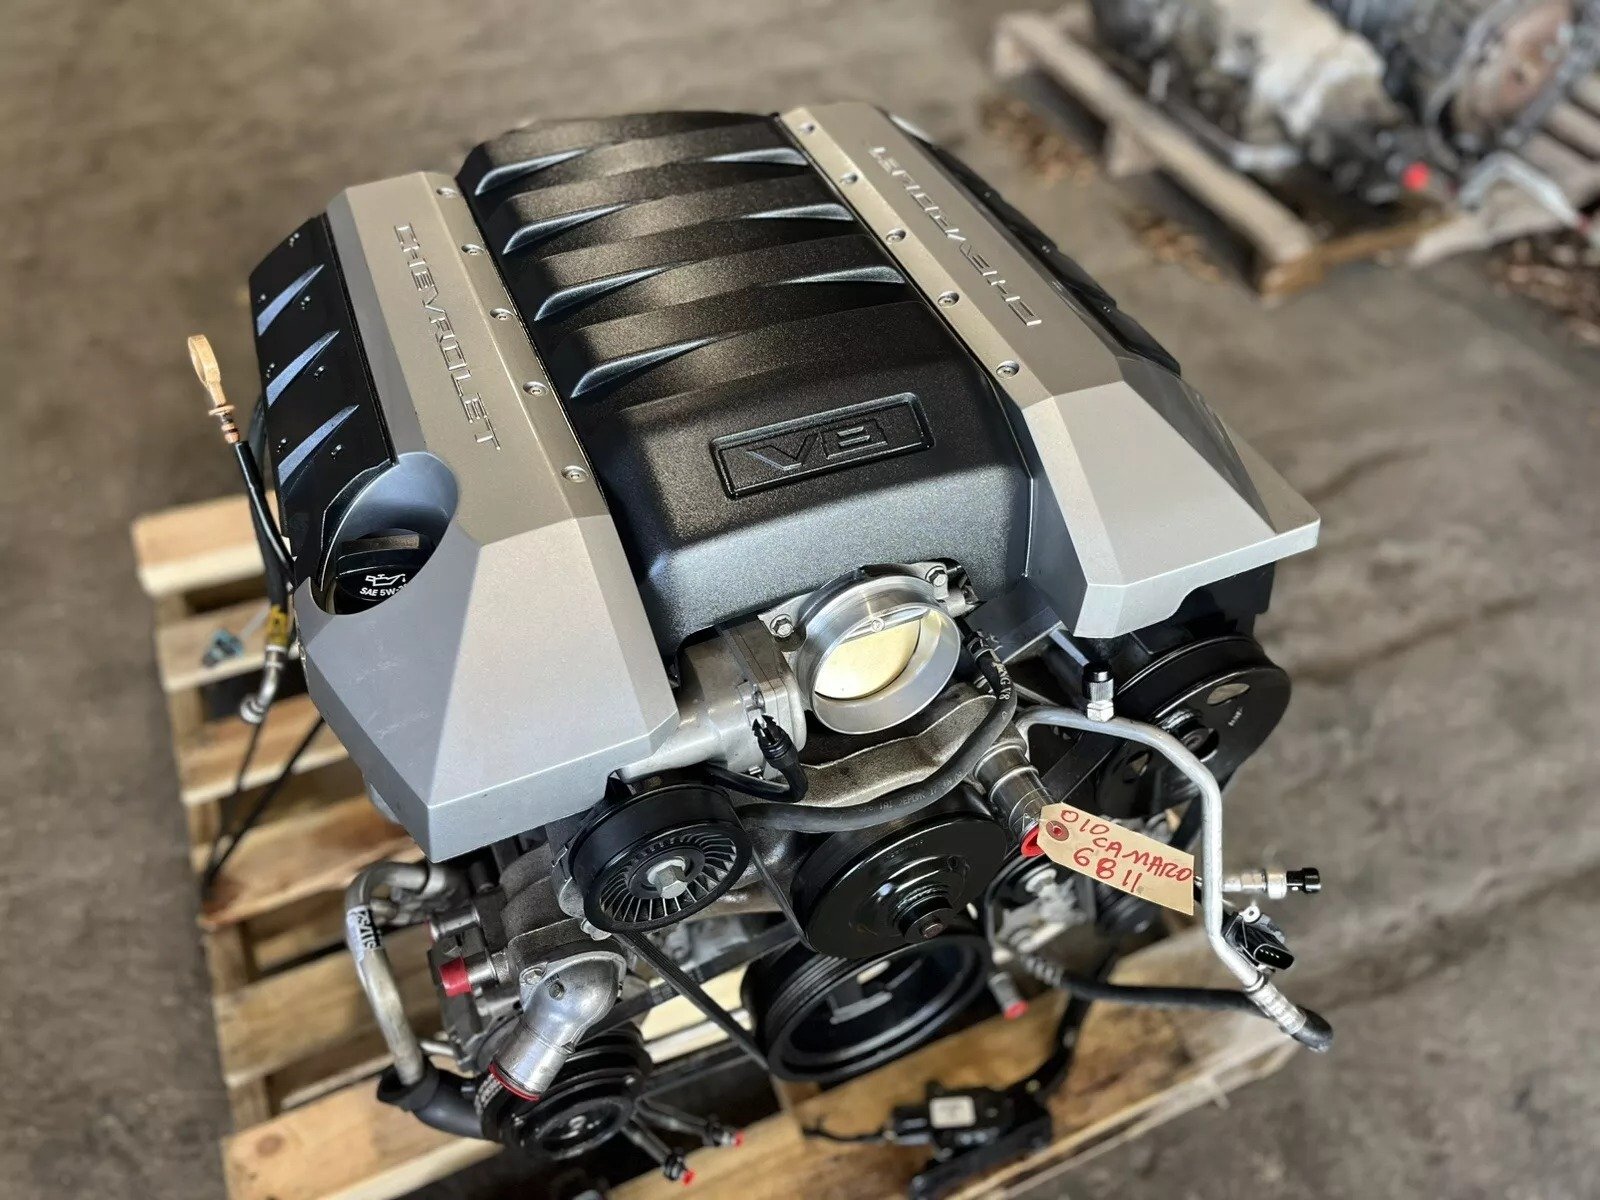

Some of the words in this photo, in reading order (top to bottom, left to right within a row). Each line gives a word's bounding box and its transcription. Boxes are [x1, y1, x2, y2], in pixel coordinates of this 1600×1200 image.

[868, 146, 1042, 327] CHEVROLET
[394, 222, 501, 451] CHEVROLET
[745, 418, 888, 472] V8
[359, 587, 378, 597] SAE
[1092, 837, 1192, 882] CAMARO
